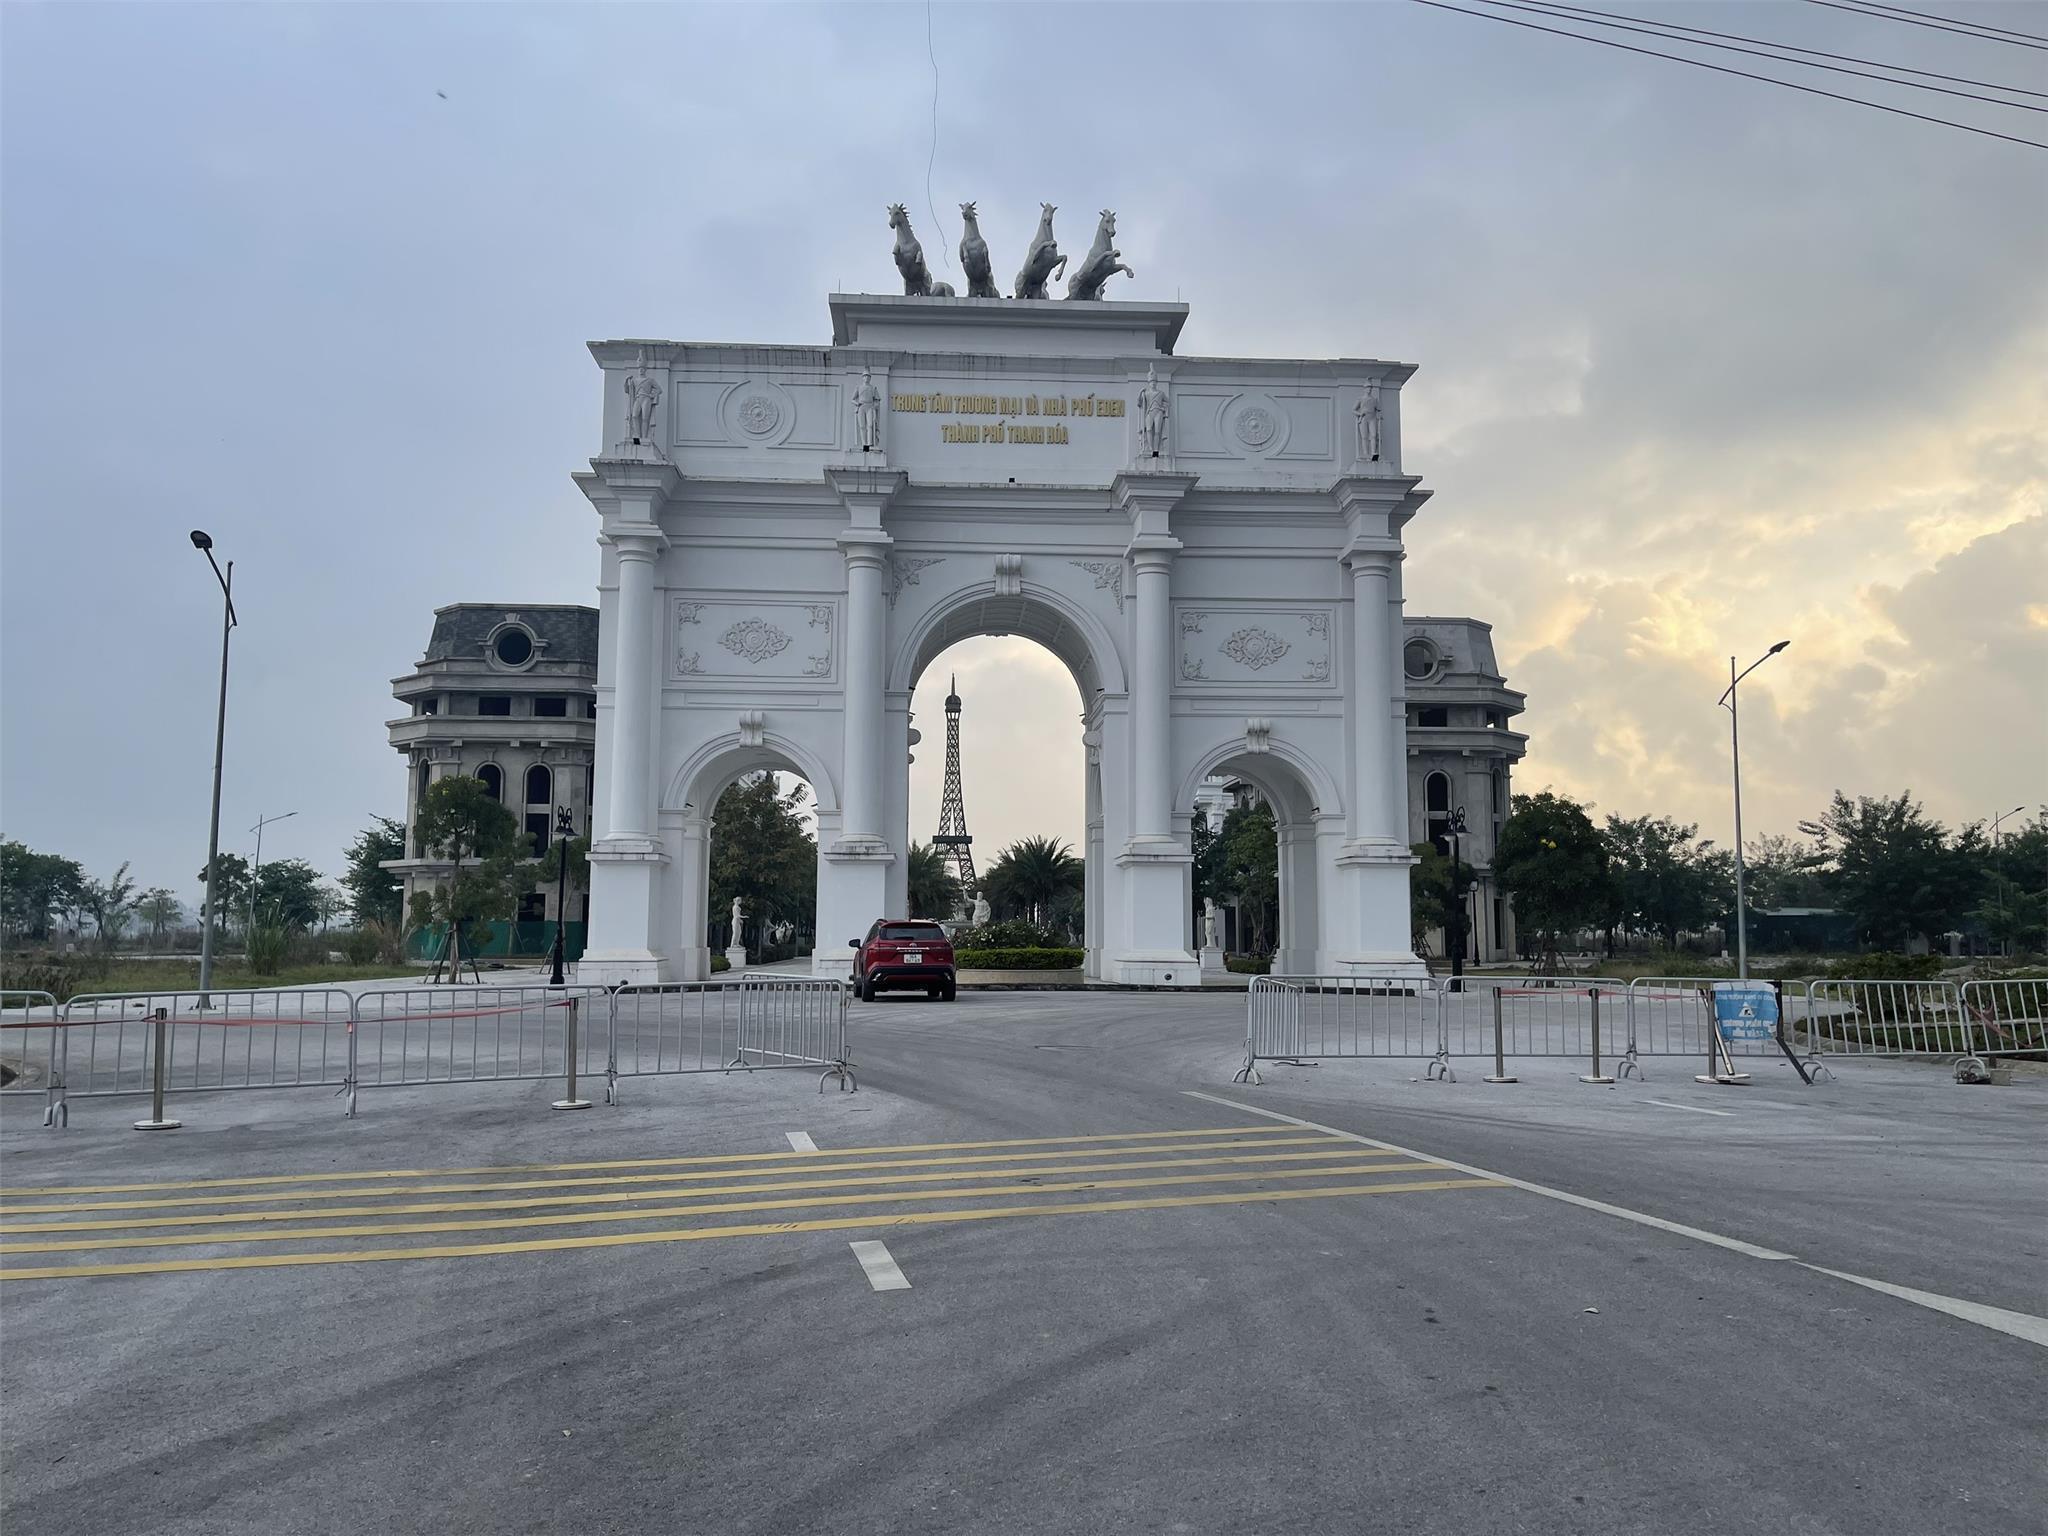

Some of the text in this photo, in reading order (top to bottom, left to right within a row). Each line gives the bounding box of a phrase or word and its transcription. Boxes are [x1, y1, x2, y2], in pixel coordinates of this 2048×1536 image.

[891, 394, 926, 413] TRUNG
[1043, 394, 1067, 416] NHÀ
[1071, 393, 1095, 416] PHỐ
[941, 420, 1069, 444] THÀNH PHỐ THANH HÓA
